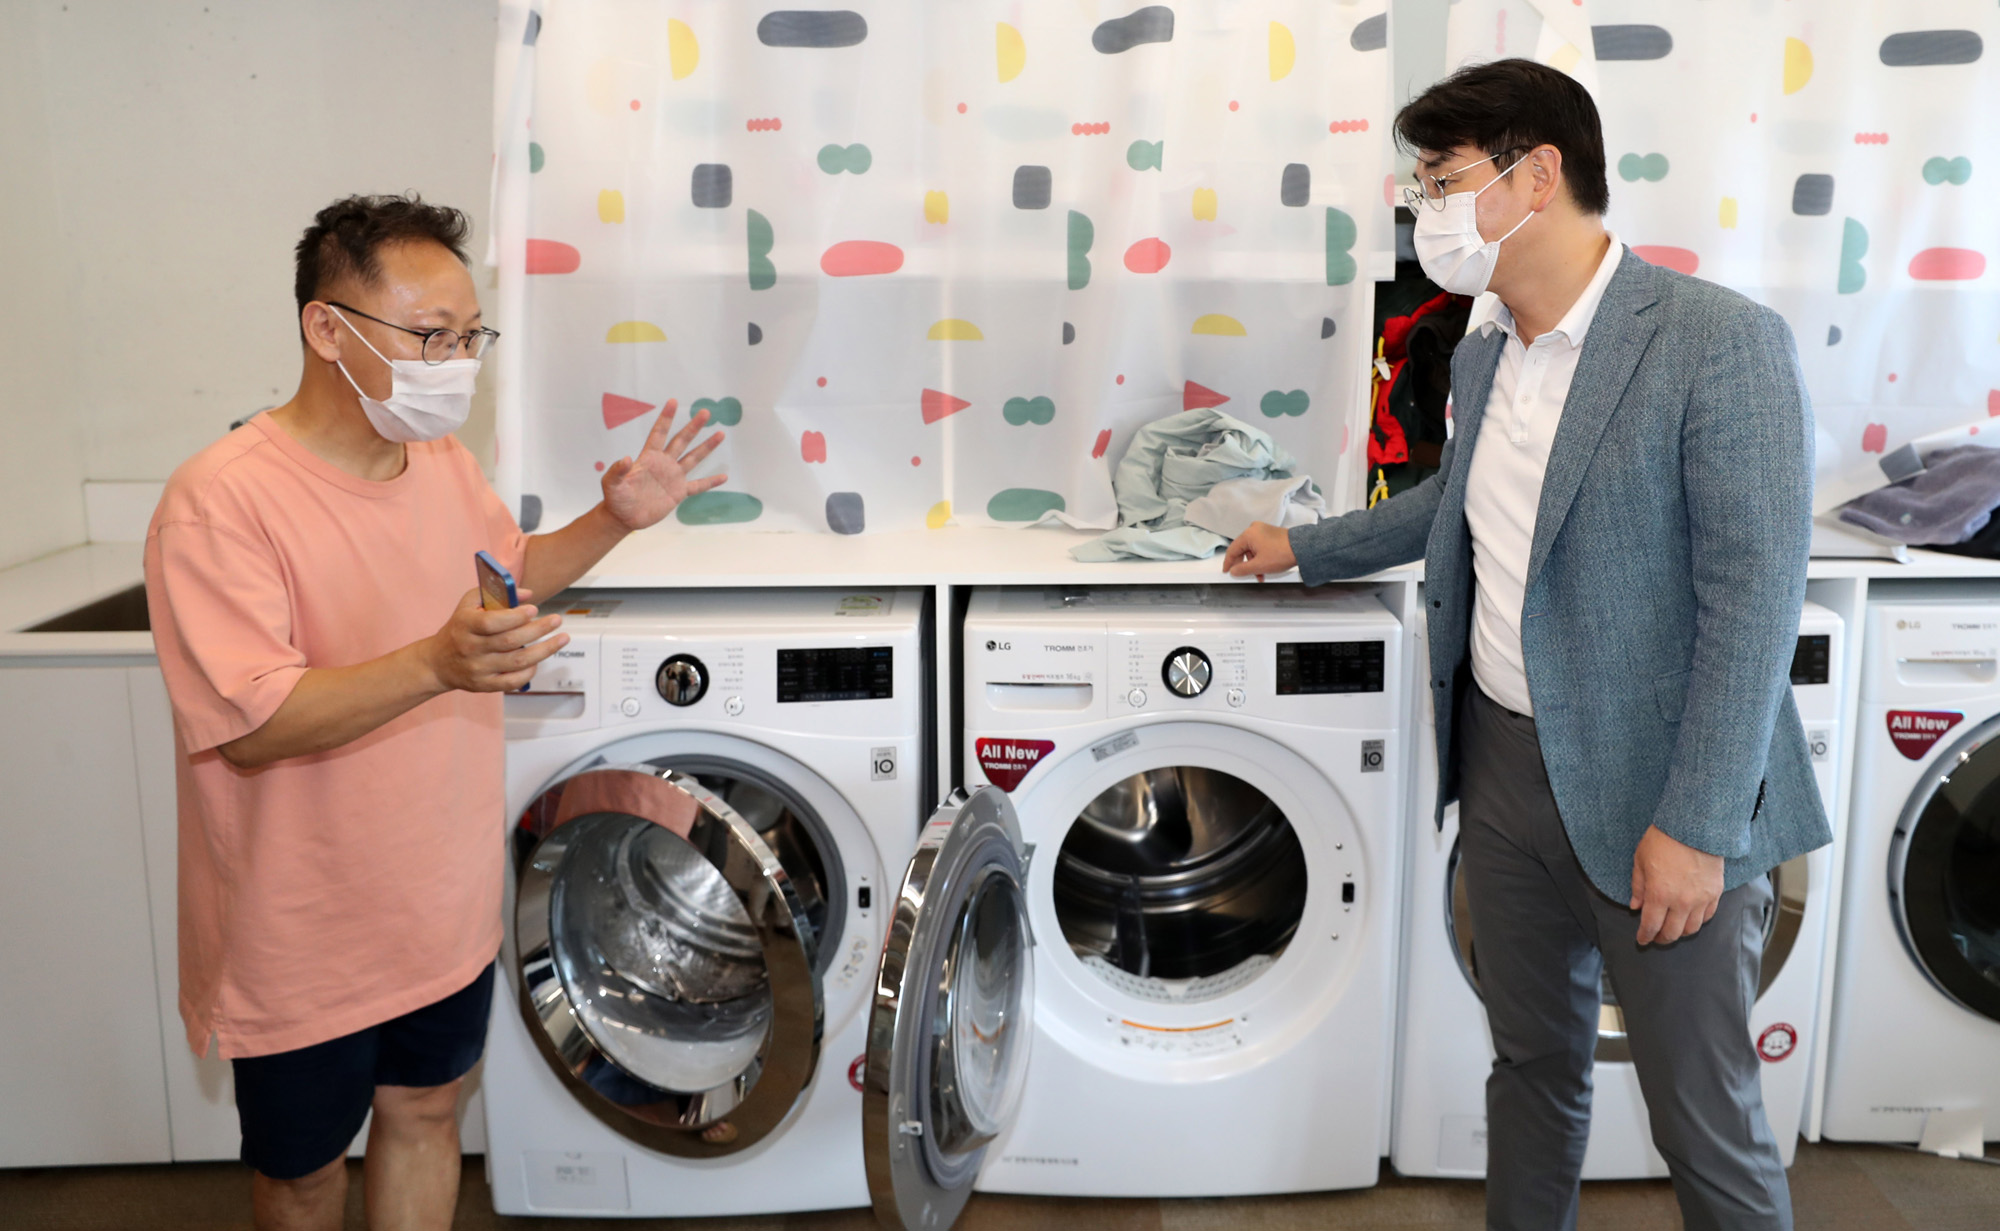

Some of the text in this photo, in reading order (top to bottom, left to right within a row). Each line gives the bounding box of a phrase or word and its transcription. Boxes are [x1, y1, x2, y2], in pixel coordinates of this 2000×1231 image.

[1891, 715, 1949, 731] All New
[981, 744, 1039, 760] All New
[984, 762, 1011, 770] TROMM
